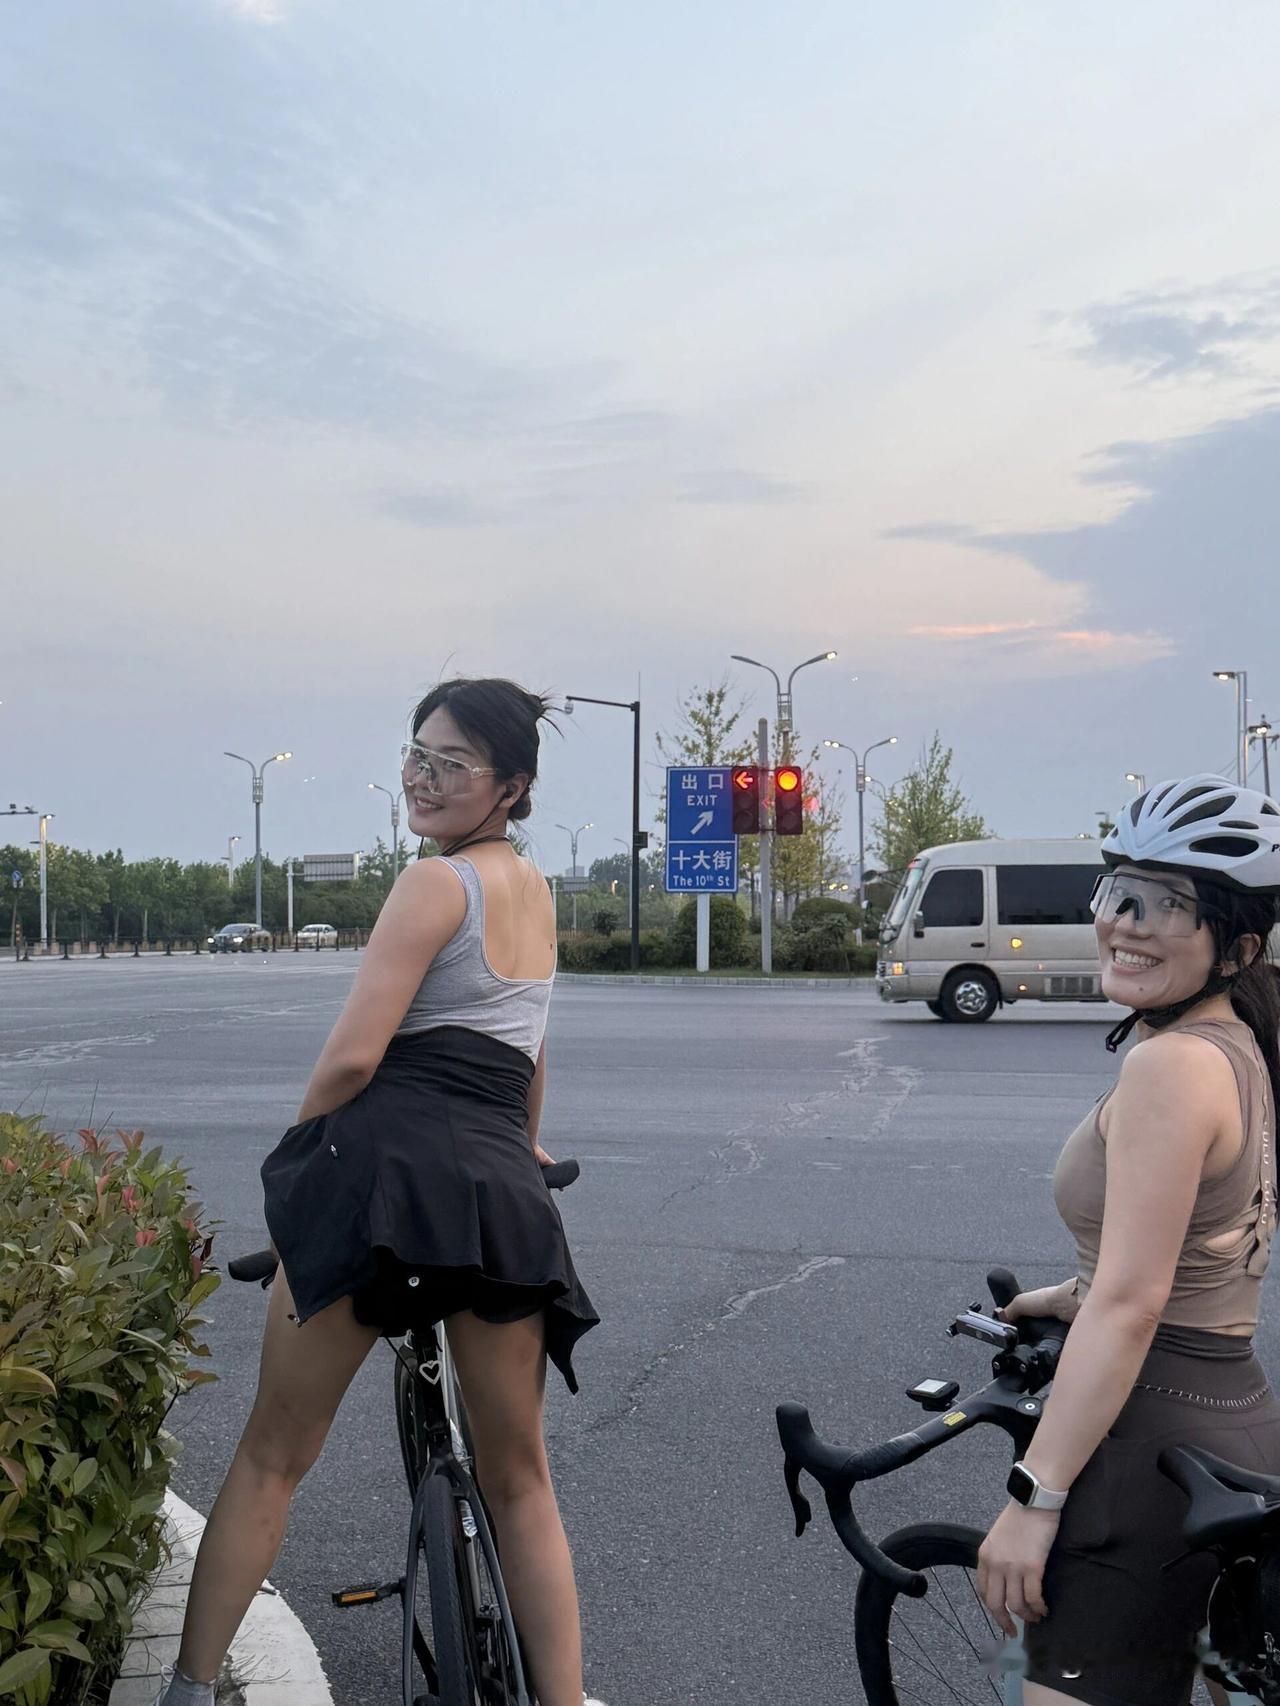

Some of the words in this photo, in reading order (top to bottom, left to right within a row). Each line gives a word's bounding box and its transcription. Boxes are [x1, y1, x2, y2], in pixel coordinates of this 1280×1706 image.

[682, 774, 723, 790] 出口
[687, 795, 718, 806] EXIT
[672, 850, 732, 870] 十大街
[672, 874, 693, 887] The
[717, 875, 730, 887] St
